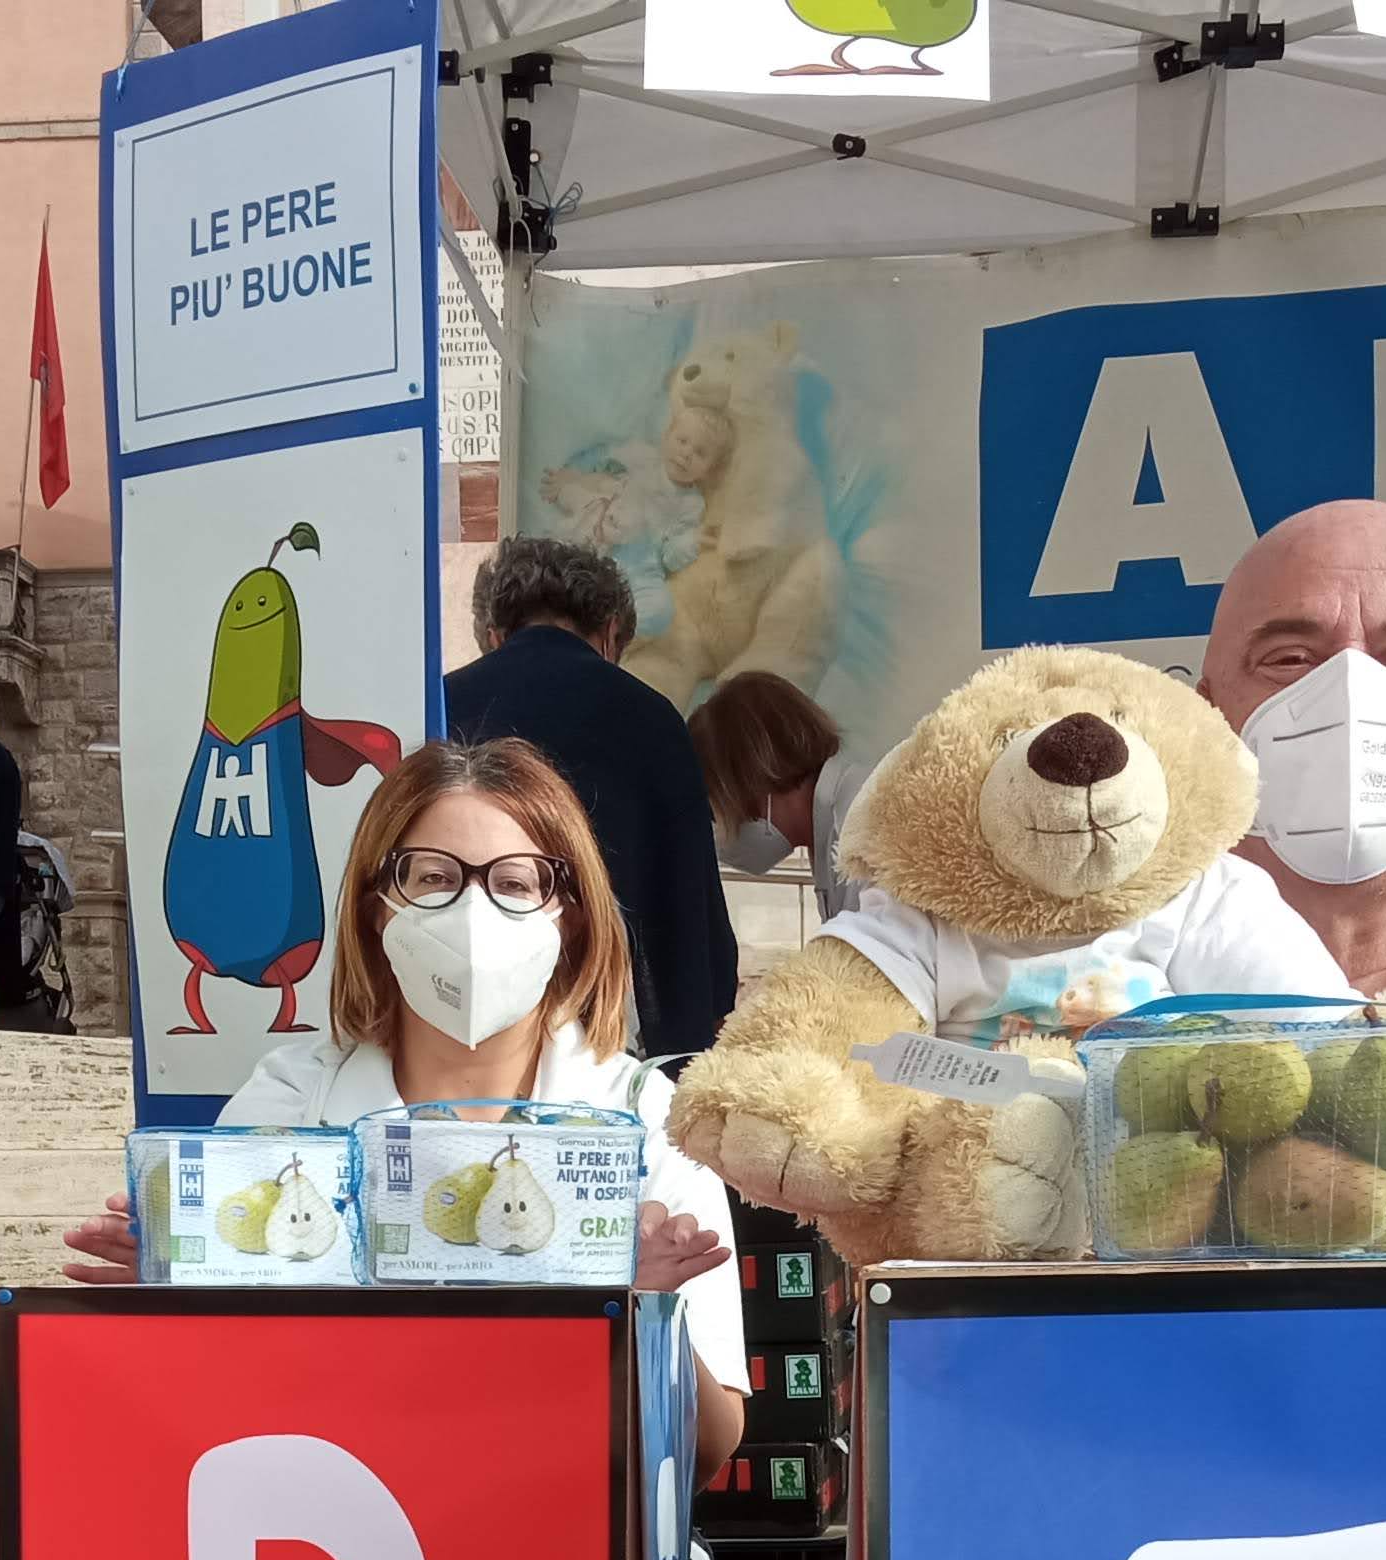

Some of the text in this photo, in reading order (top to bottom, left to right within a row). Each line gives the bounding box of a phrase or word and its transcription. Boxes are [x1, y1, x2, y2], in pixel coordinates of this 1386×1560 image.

[190, 182, 337, 257] LE PERE
[243, 242, 373, 310] BUONE
[556, 1151, 573, 1165] LE
[579, 1151, 612, 1166] PERE
[556, 1168, 617, 1183] AIUTANO
[575, 1186, 589, 1200] IN
[780, 1286, 813, 1295] SALVI
[788, 1386, 819, 1396] SALVI
